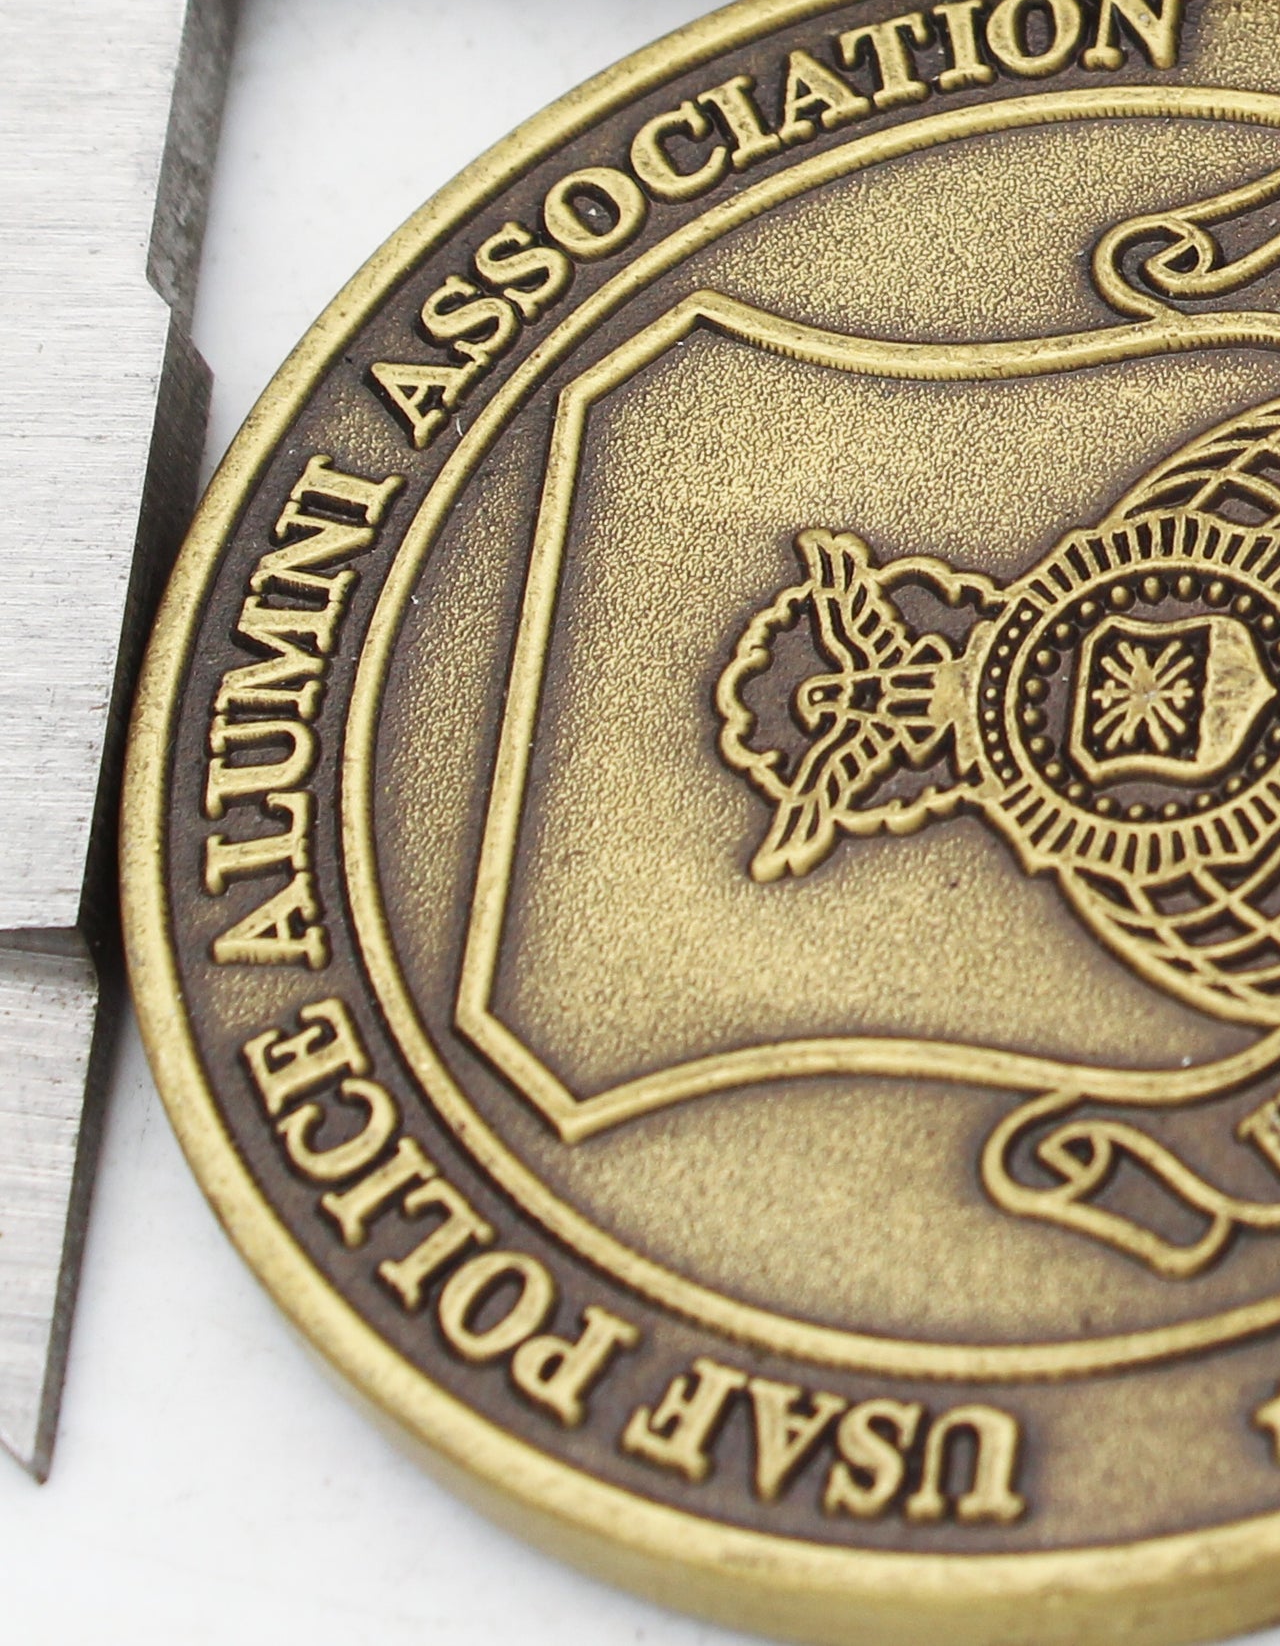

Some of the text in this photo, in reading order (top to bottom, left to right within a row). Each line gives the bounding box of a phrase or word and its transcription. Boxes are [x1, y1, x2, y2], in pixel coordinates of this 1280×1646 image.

[205, 453, 407, 969] ALUMNI
[243, 997, 641, 1427] POLICE
[623, 1357, 1026, 1521] USAF
